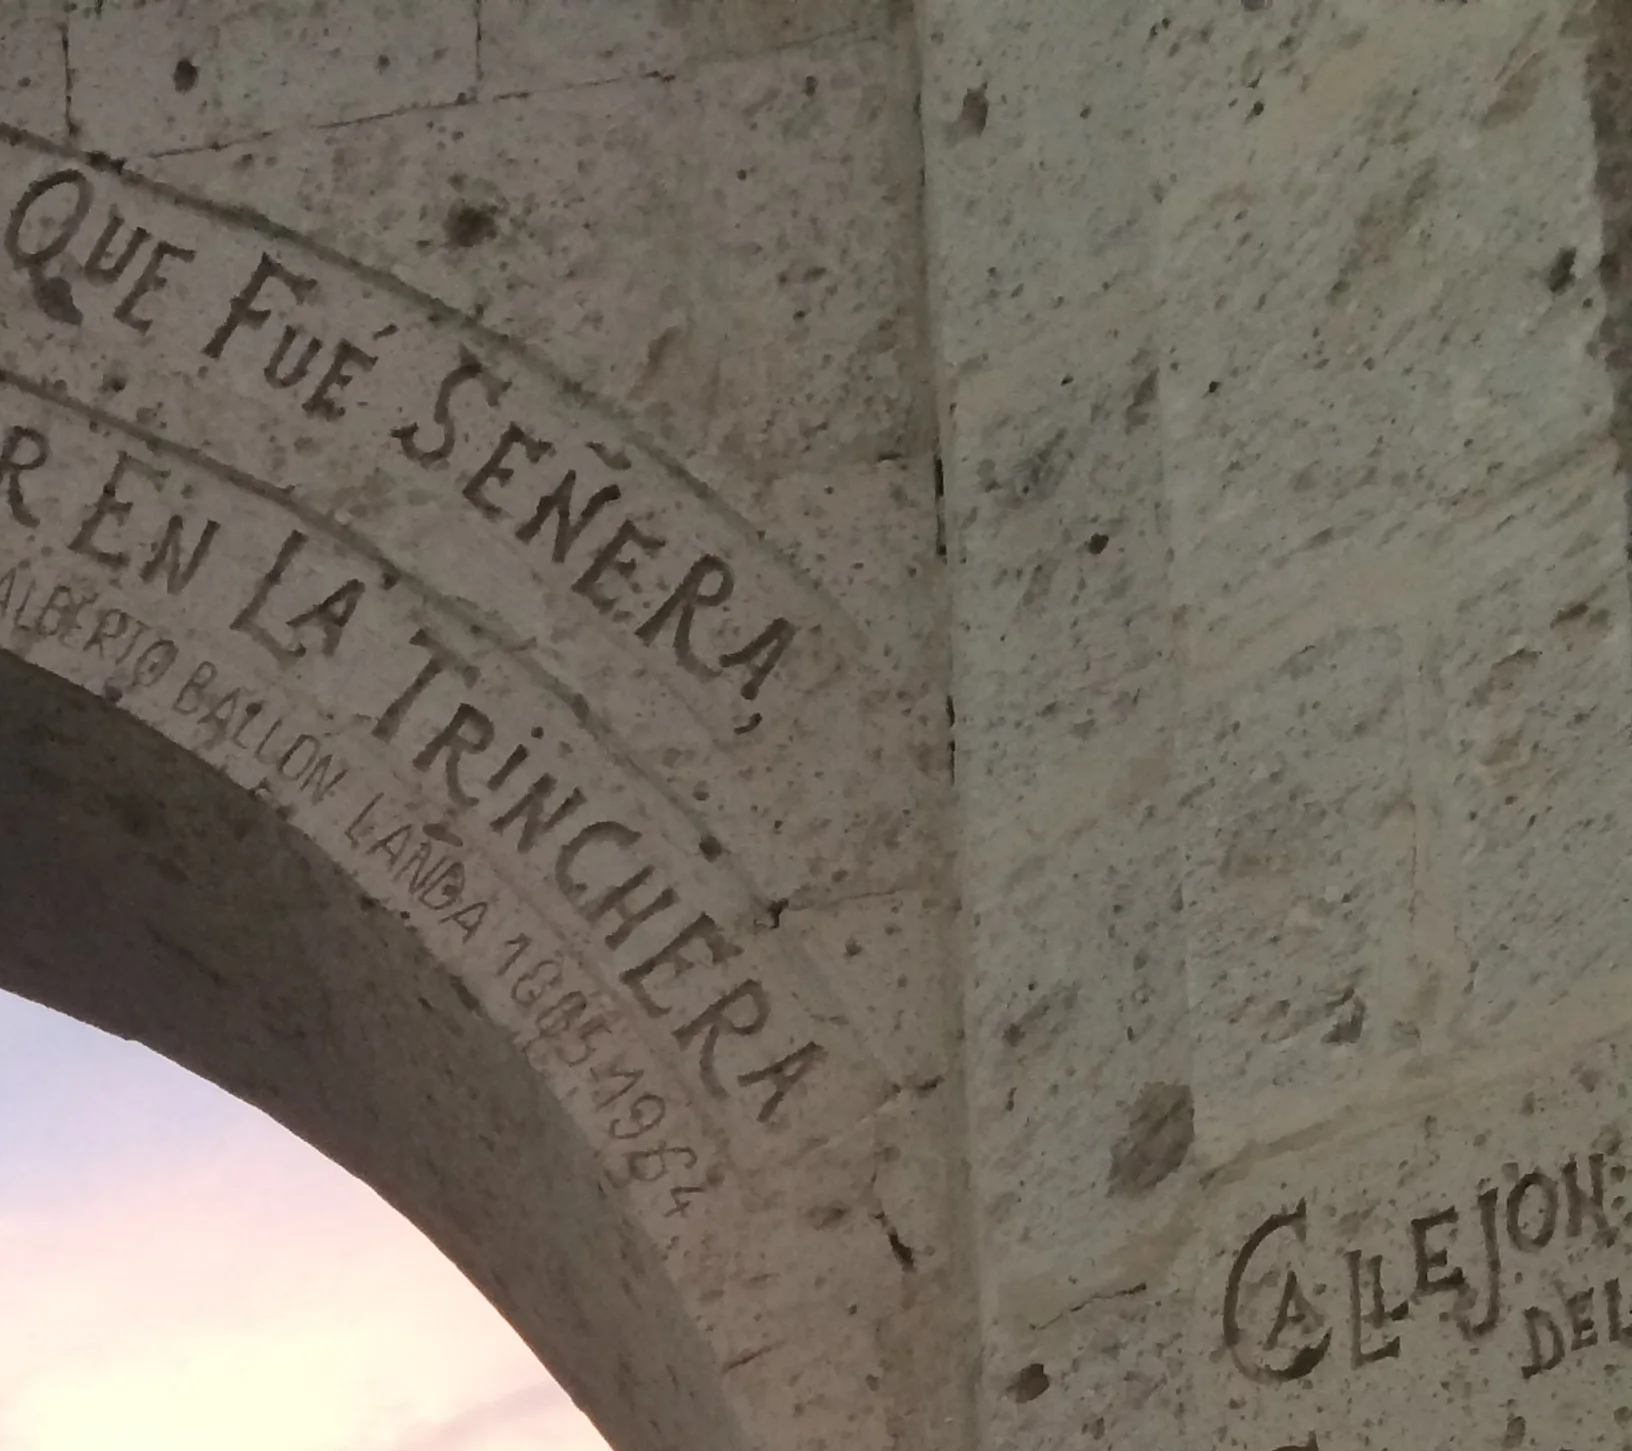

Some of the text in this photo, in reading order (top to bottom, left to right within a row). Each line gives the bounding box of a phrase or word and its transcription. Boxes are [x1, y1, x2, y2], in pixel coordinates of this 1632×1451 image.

[3, 169, 196, 334] QUE
[68, 450, 222, 595] EN
[229, 529, 366, 659] LA
[373, 627, 830, 1124] TRINCHERA
[172, 659, 350, 804] BALLON
[1222, 1152, 1618, 1384] CALLEJON
[1521, 1277, 1632, 1379] DEL
